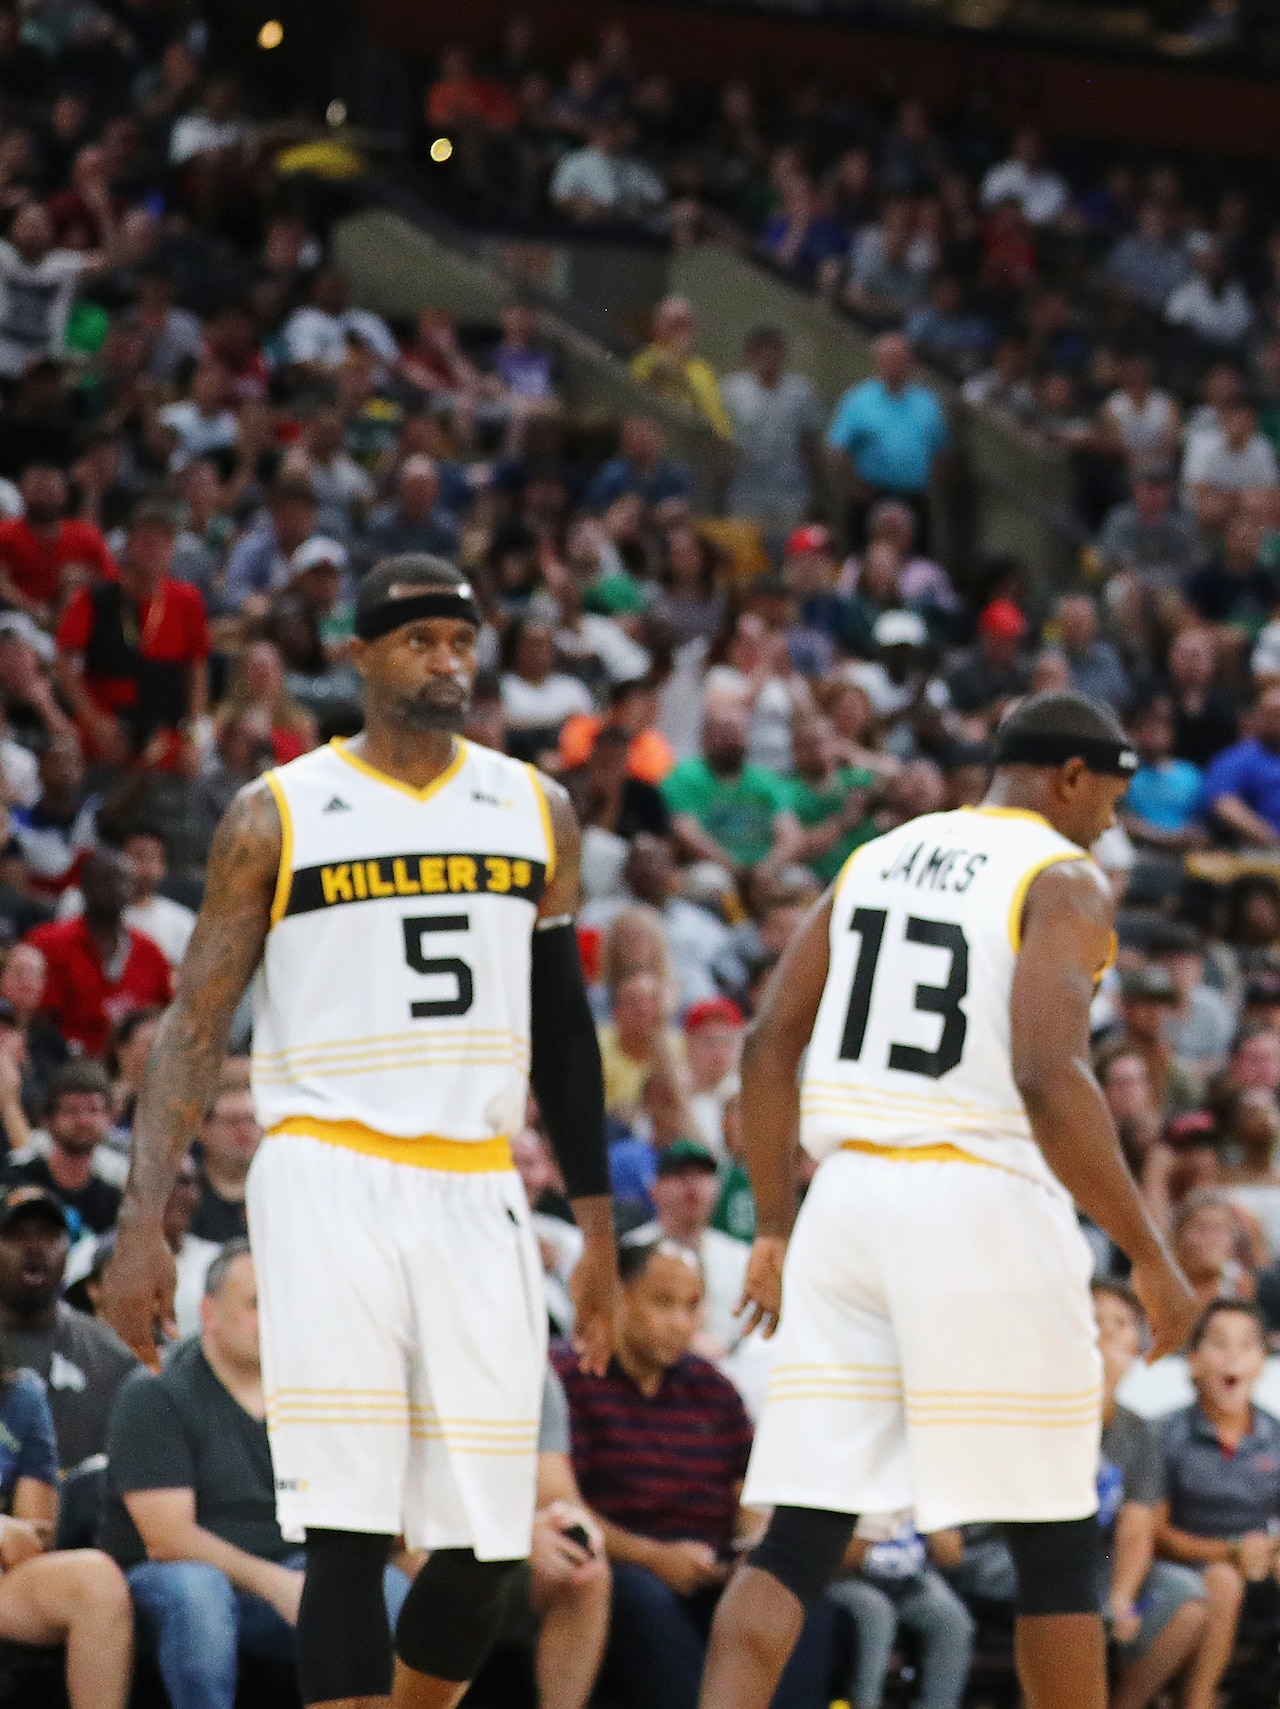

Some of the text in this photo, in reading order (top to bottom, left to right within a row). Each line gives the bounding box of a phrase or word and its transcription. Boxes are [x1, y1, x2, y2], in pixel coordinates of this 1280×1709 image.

[320, 855, 479, 905] KILLER
[880, 840, 988, 893] JAMES
[402, 914, 474, 1018] 5
[837, 907, 969, 1081] 13
